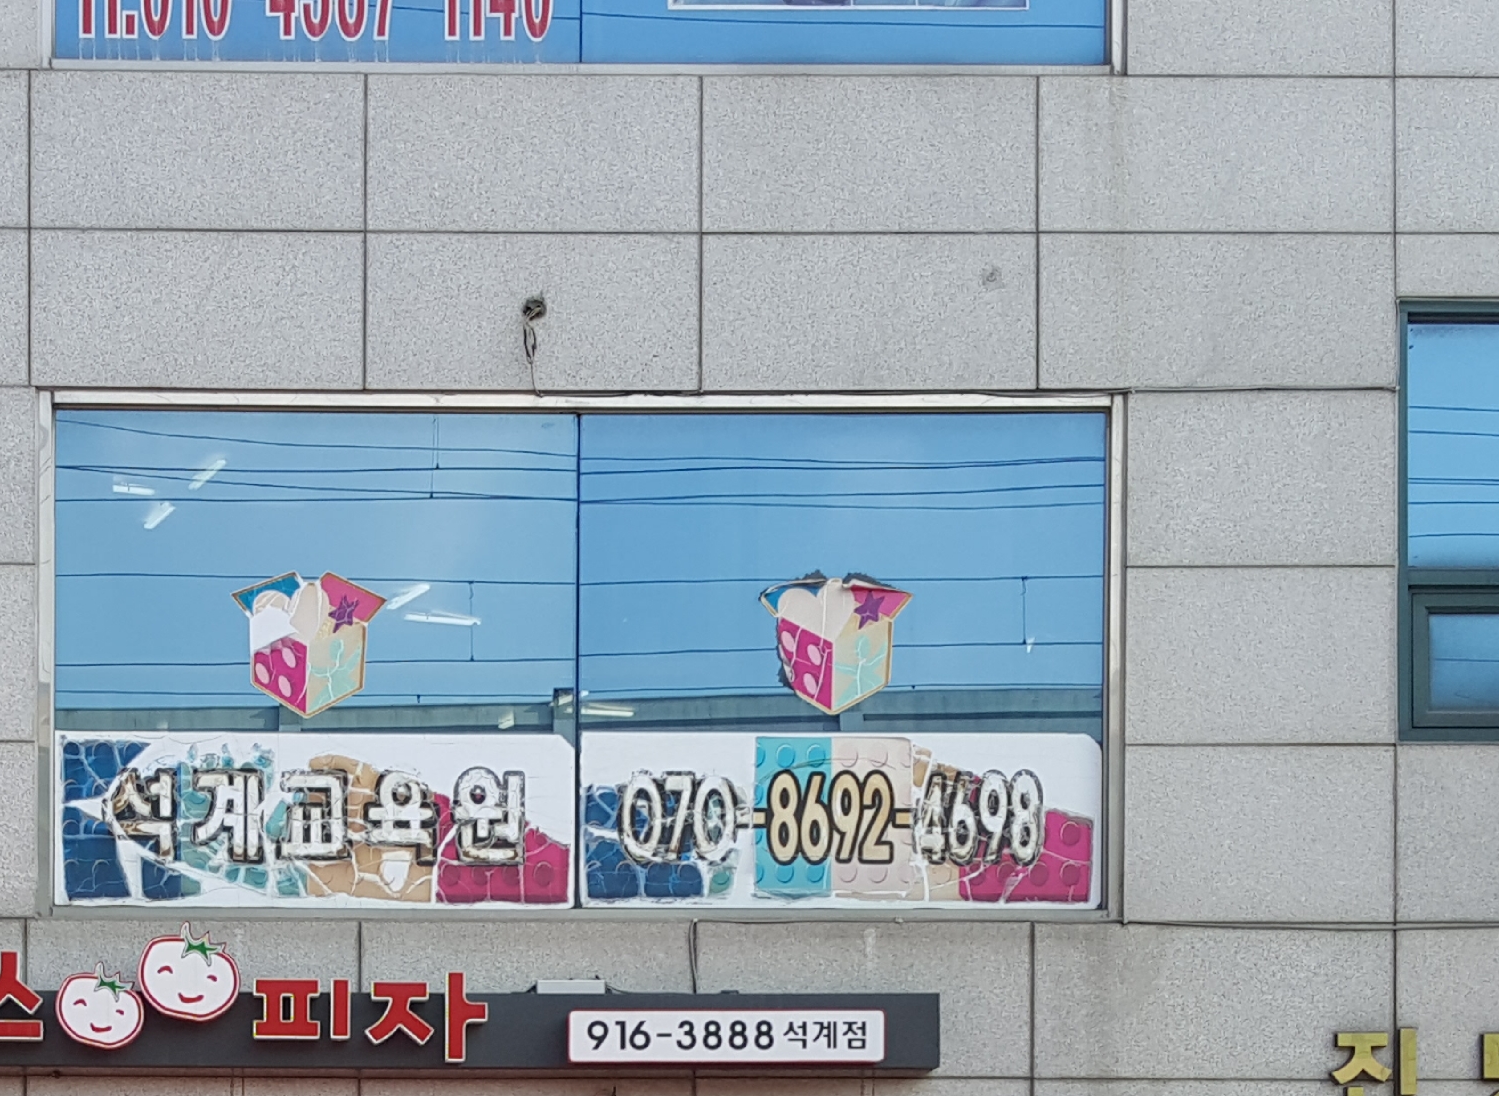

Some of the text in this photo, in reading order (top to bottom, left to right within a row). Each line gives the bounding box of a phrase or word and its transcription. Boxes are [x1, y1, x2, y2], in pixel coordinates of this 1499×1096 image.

[103, 766, 527, 867] 석계교육원
[619, 769, 1045, 867] 070-8692-4698
[254, 971, 489, 1063] 피자
[586, 1019, 868, 1052] 916-3888 석계점
